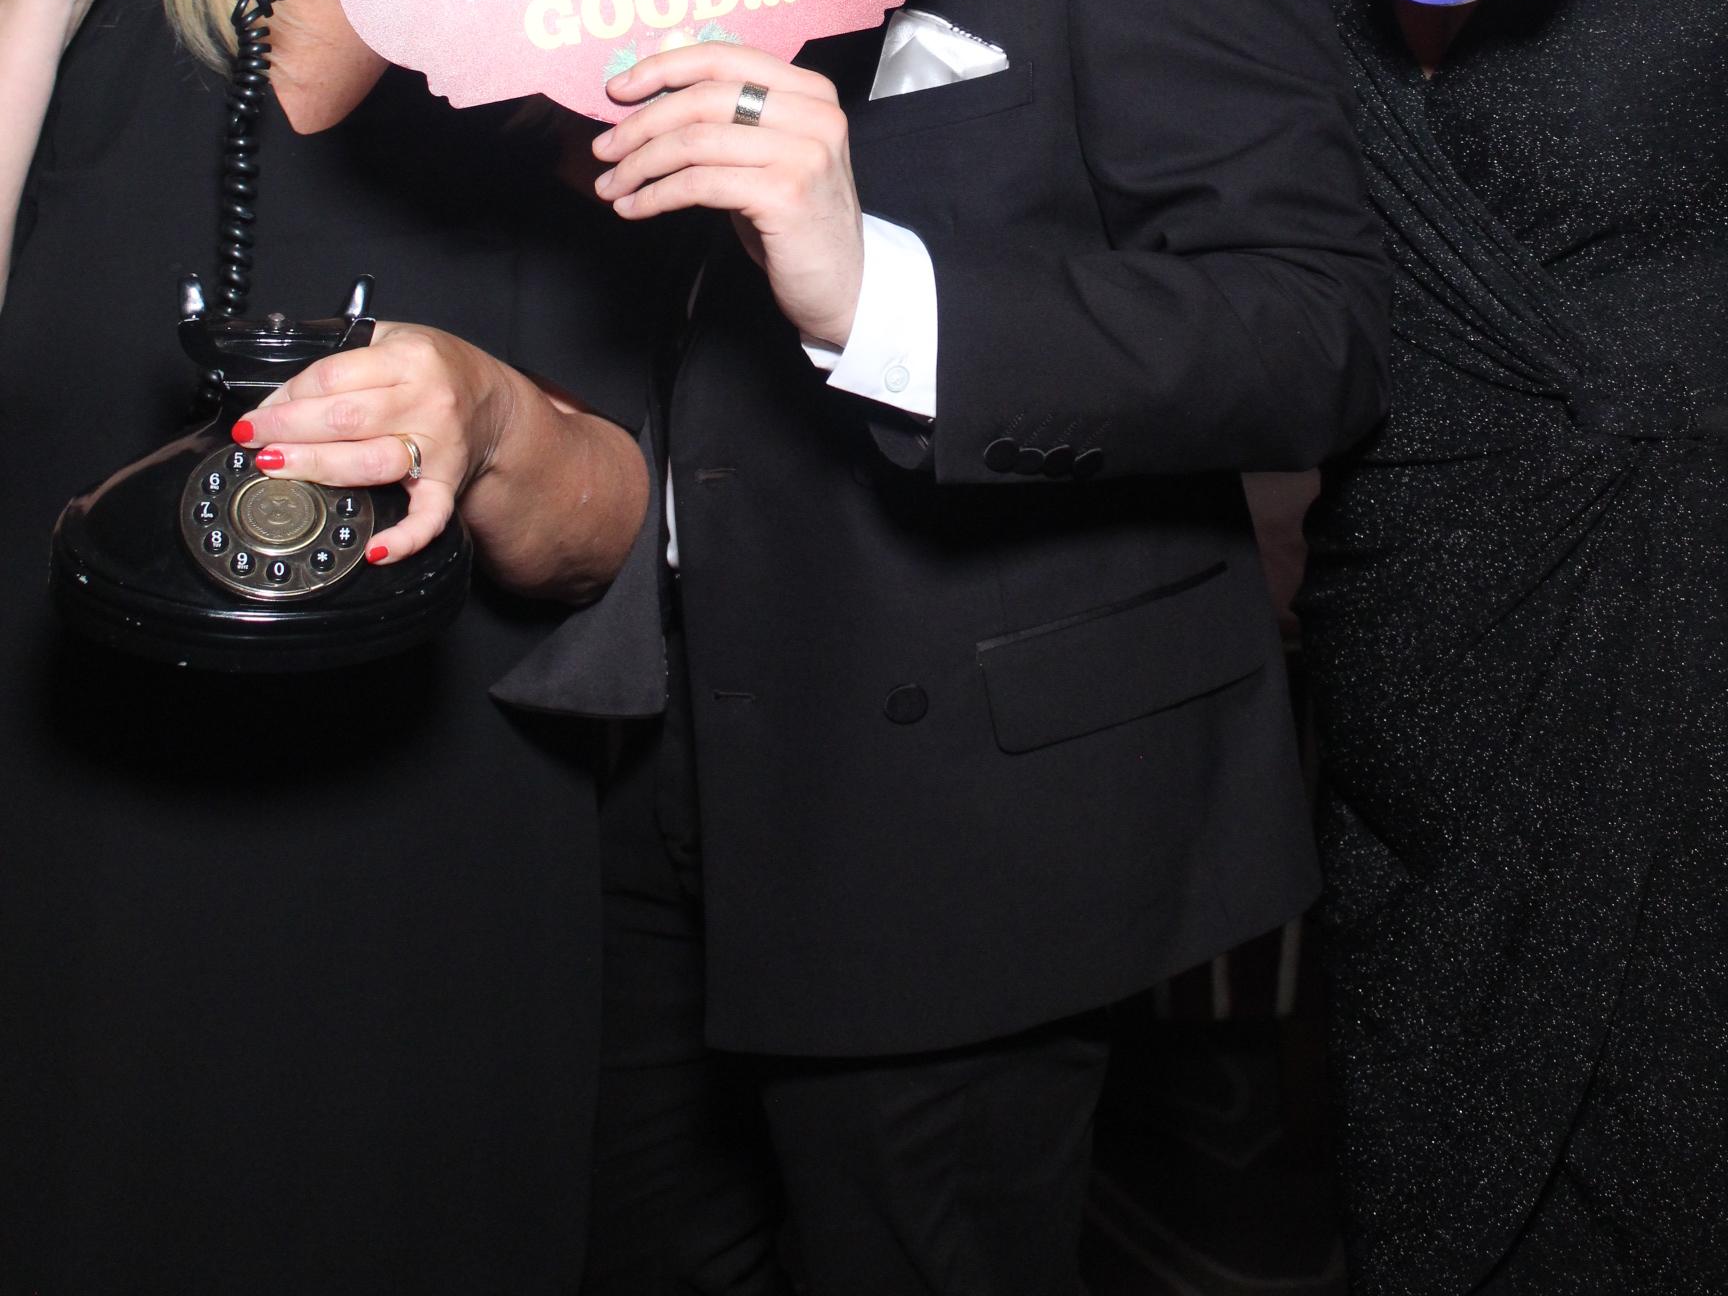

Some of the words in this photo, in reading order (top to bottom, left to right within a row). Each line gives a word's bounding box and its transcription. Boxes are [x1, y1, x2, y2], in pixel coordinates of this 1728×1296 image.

[233, 452, 244, 465] 5
[209, 473, 220, 486] 6
[200, 502, 210, 514] 7
[346, 498, 353, 511] 1
[211, 530, 222, 543] 8
[237, 552, 248, 565] 9
[274, 562, 285, 576] 0
